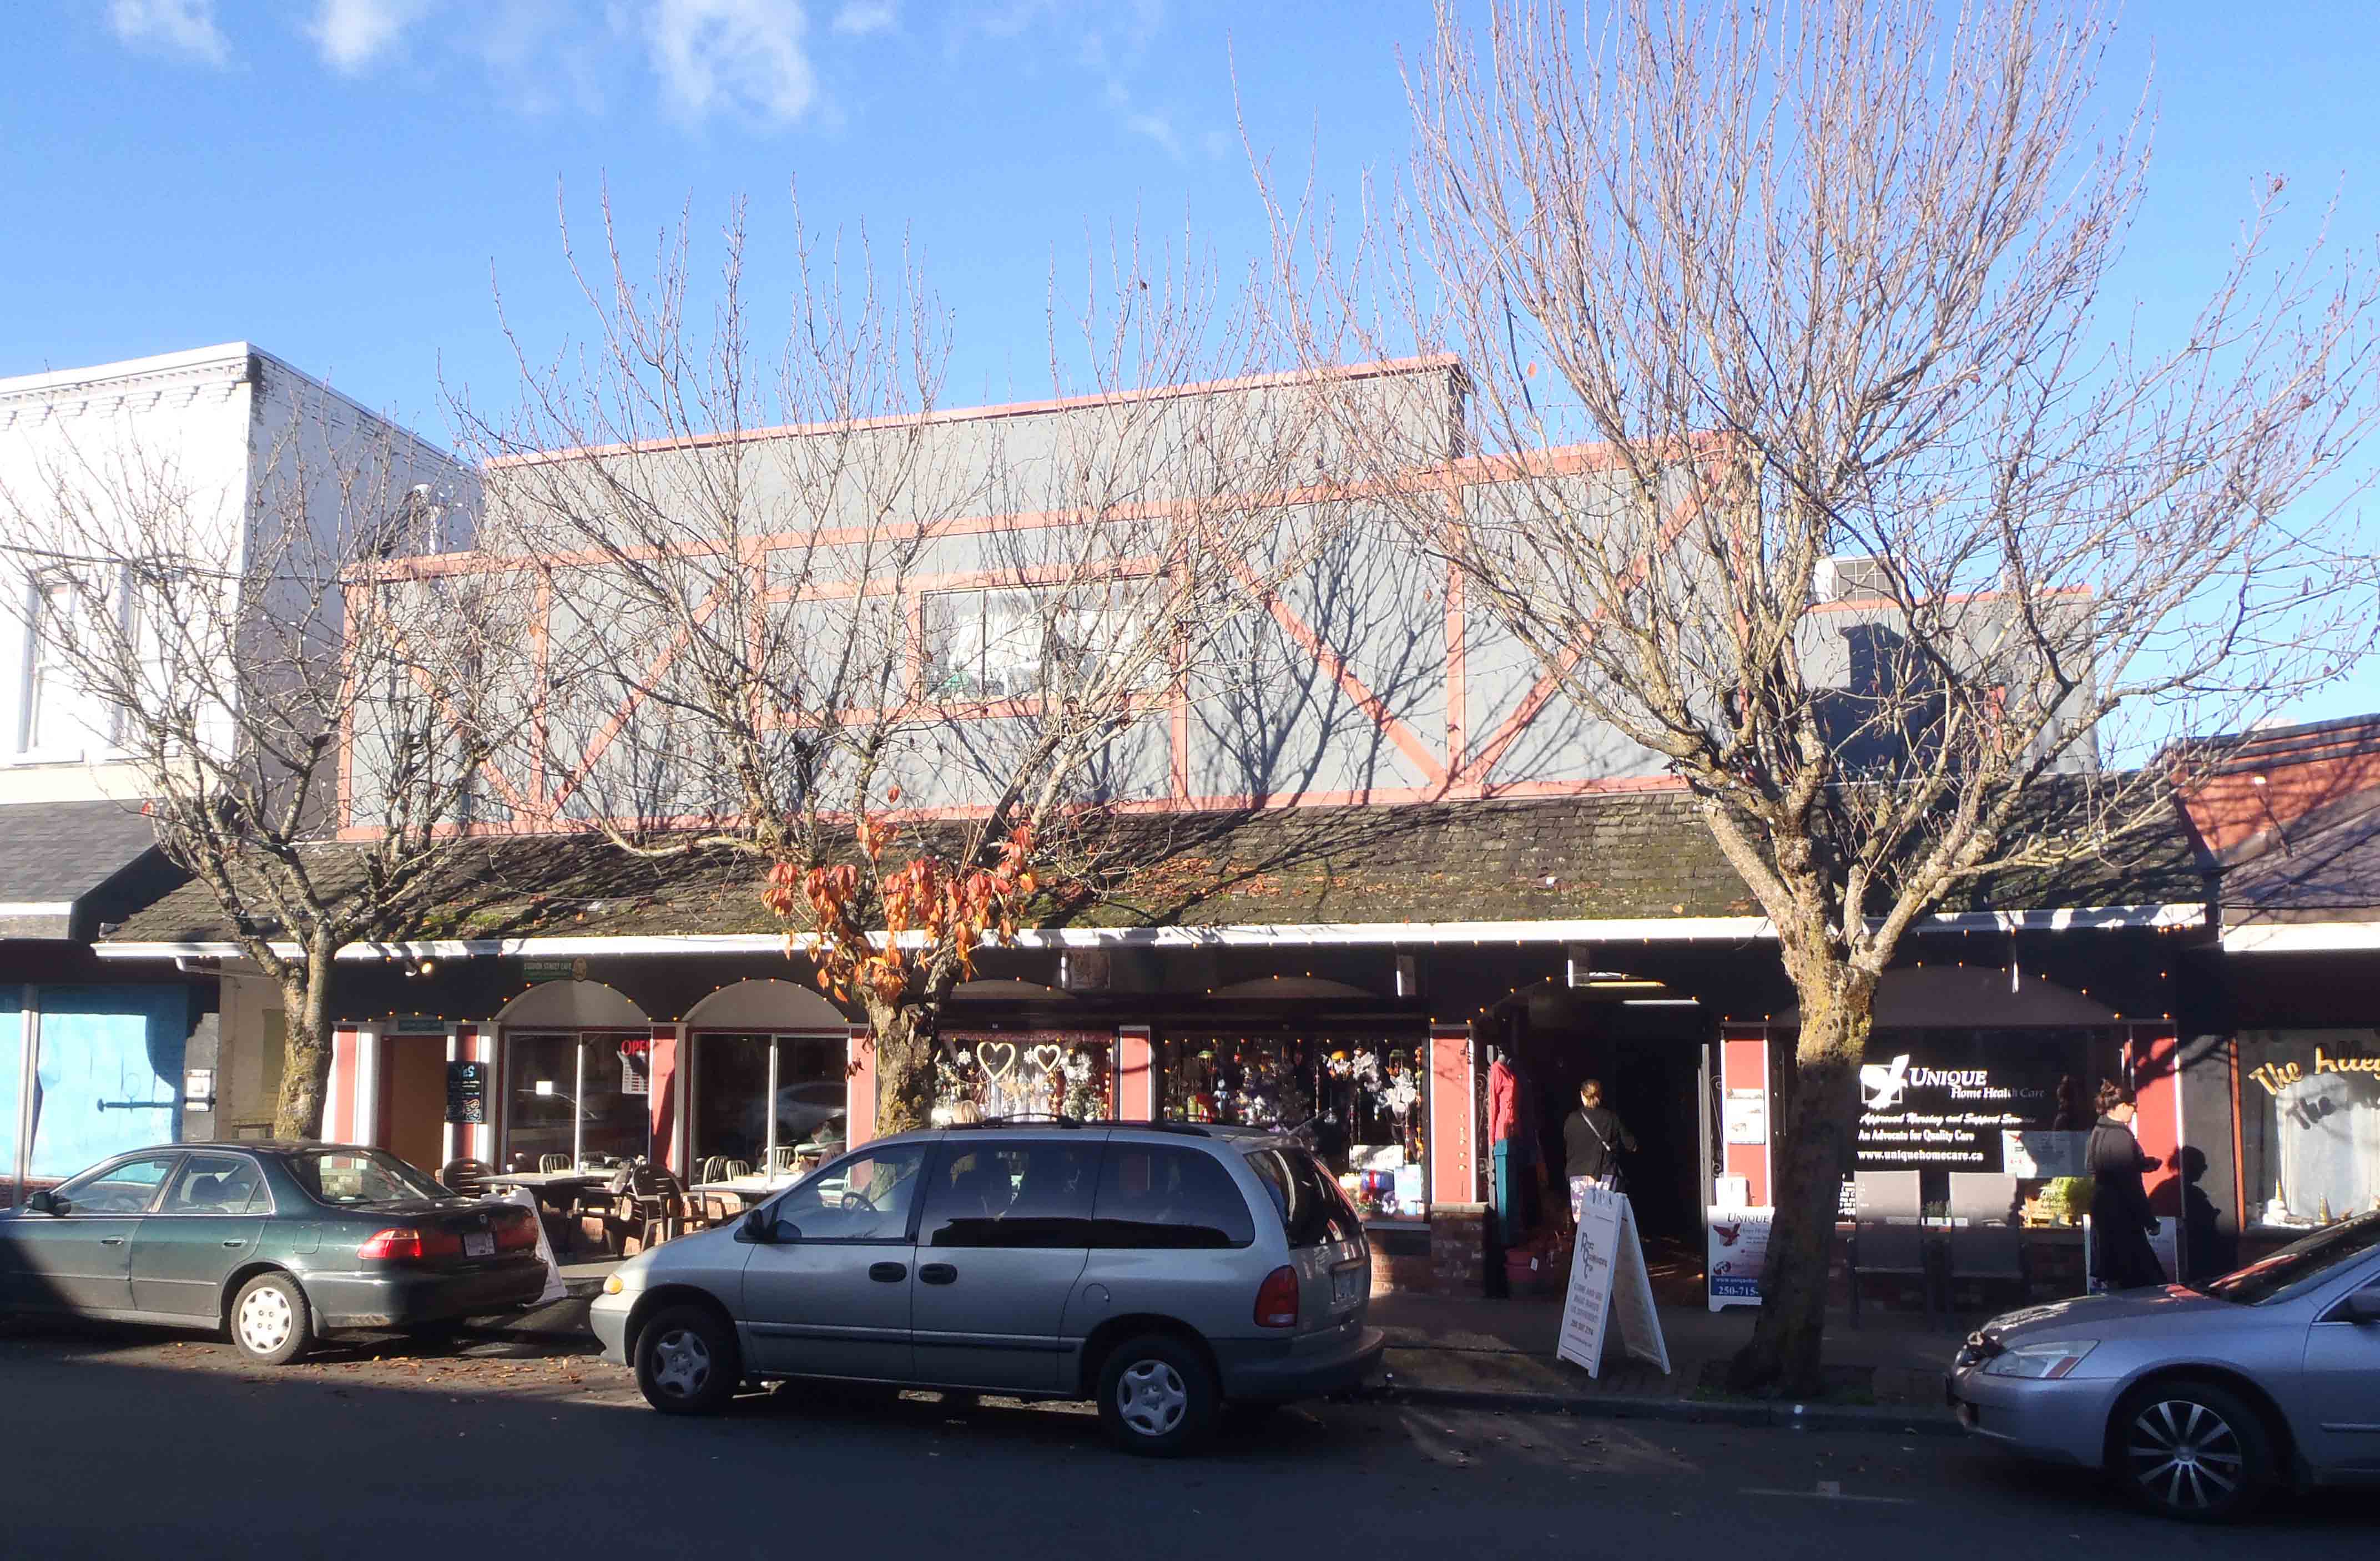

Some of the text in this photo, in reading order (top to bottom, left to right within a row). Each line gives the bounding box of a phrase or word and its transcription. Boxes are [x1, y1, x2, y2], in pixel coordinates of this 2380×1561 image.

[2248, 1062, 2303, 1095] The
[1950, 1087, 1982, 1099] Home
[2020, 1087, 2045, 1098] Care
[1945, 1113, 1963, 1124] and
[1858, 1128, 1975, 1143] An Advocate for Quality Care
[1857, 1149, 1984, 1163] www.uniquehomecare.ca
